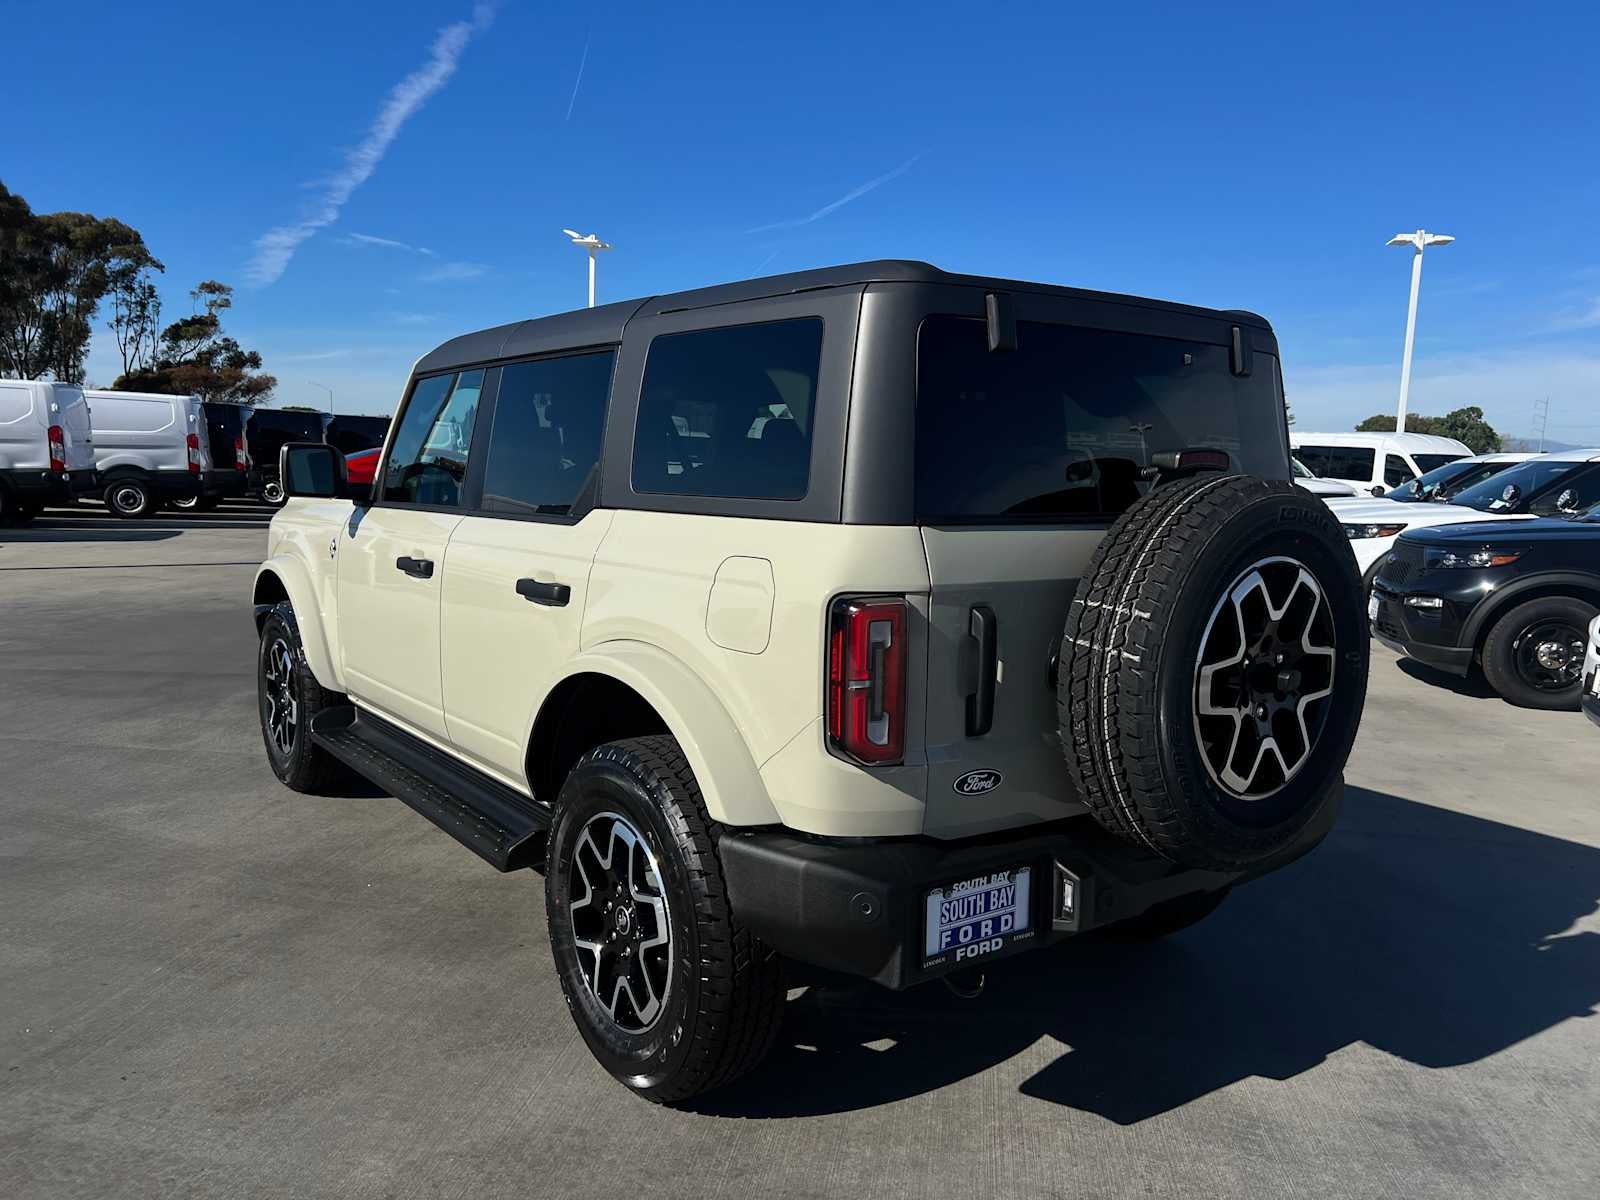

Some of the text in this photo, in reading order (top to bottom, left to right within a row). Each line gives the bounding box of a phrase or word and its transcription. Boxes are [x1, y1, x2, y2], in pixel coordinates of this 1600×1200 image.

[962, 773, 996, 792] Ford
[952, 870, 1011, 893] SOUTH BAY
[941, 885, 1015, 924] SOUTH BAY
[956, 937, 1004, 962] FORD
